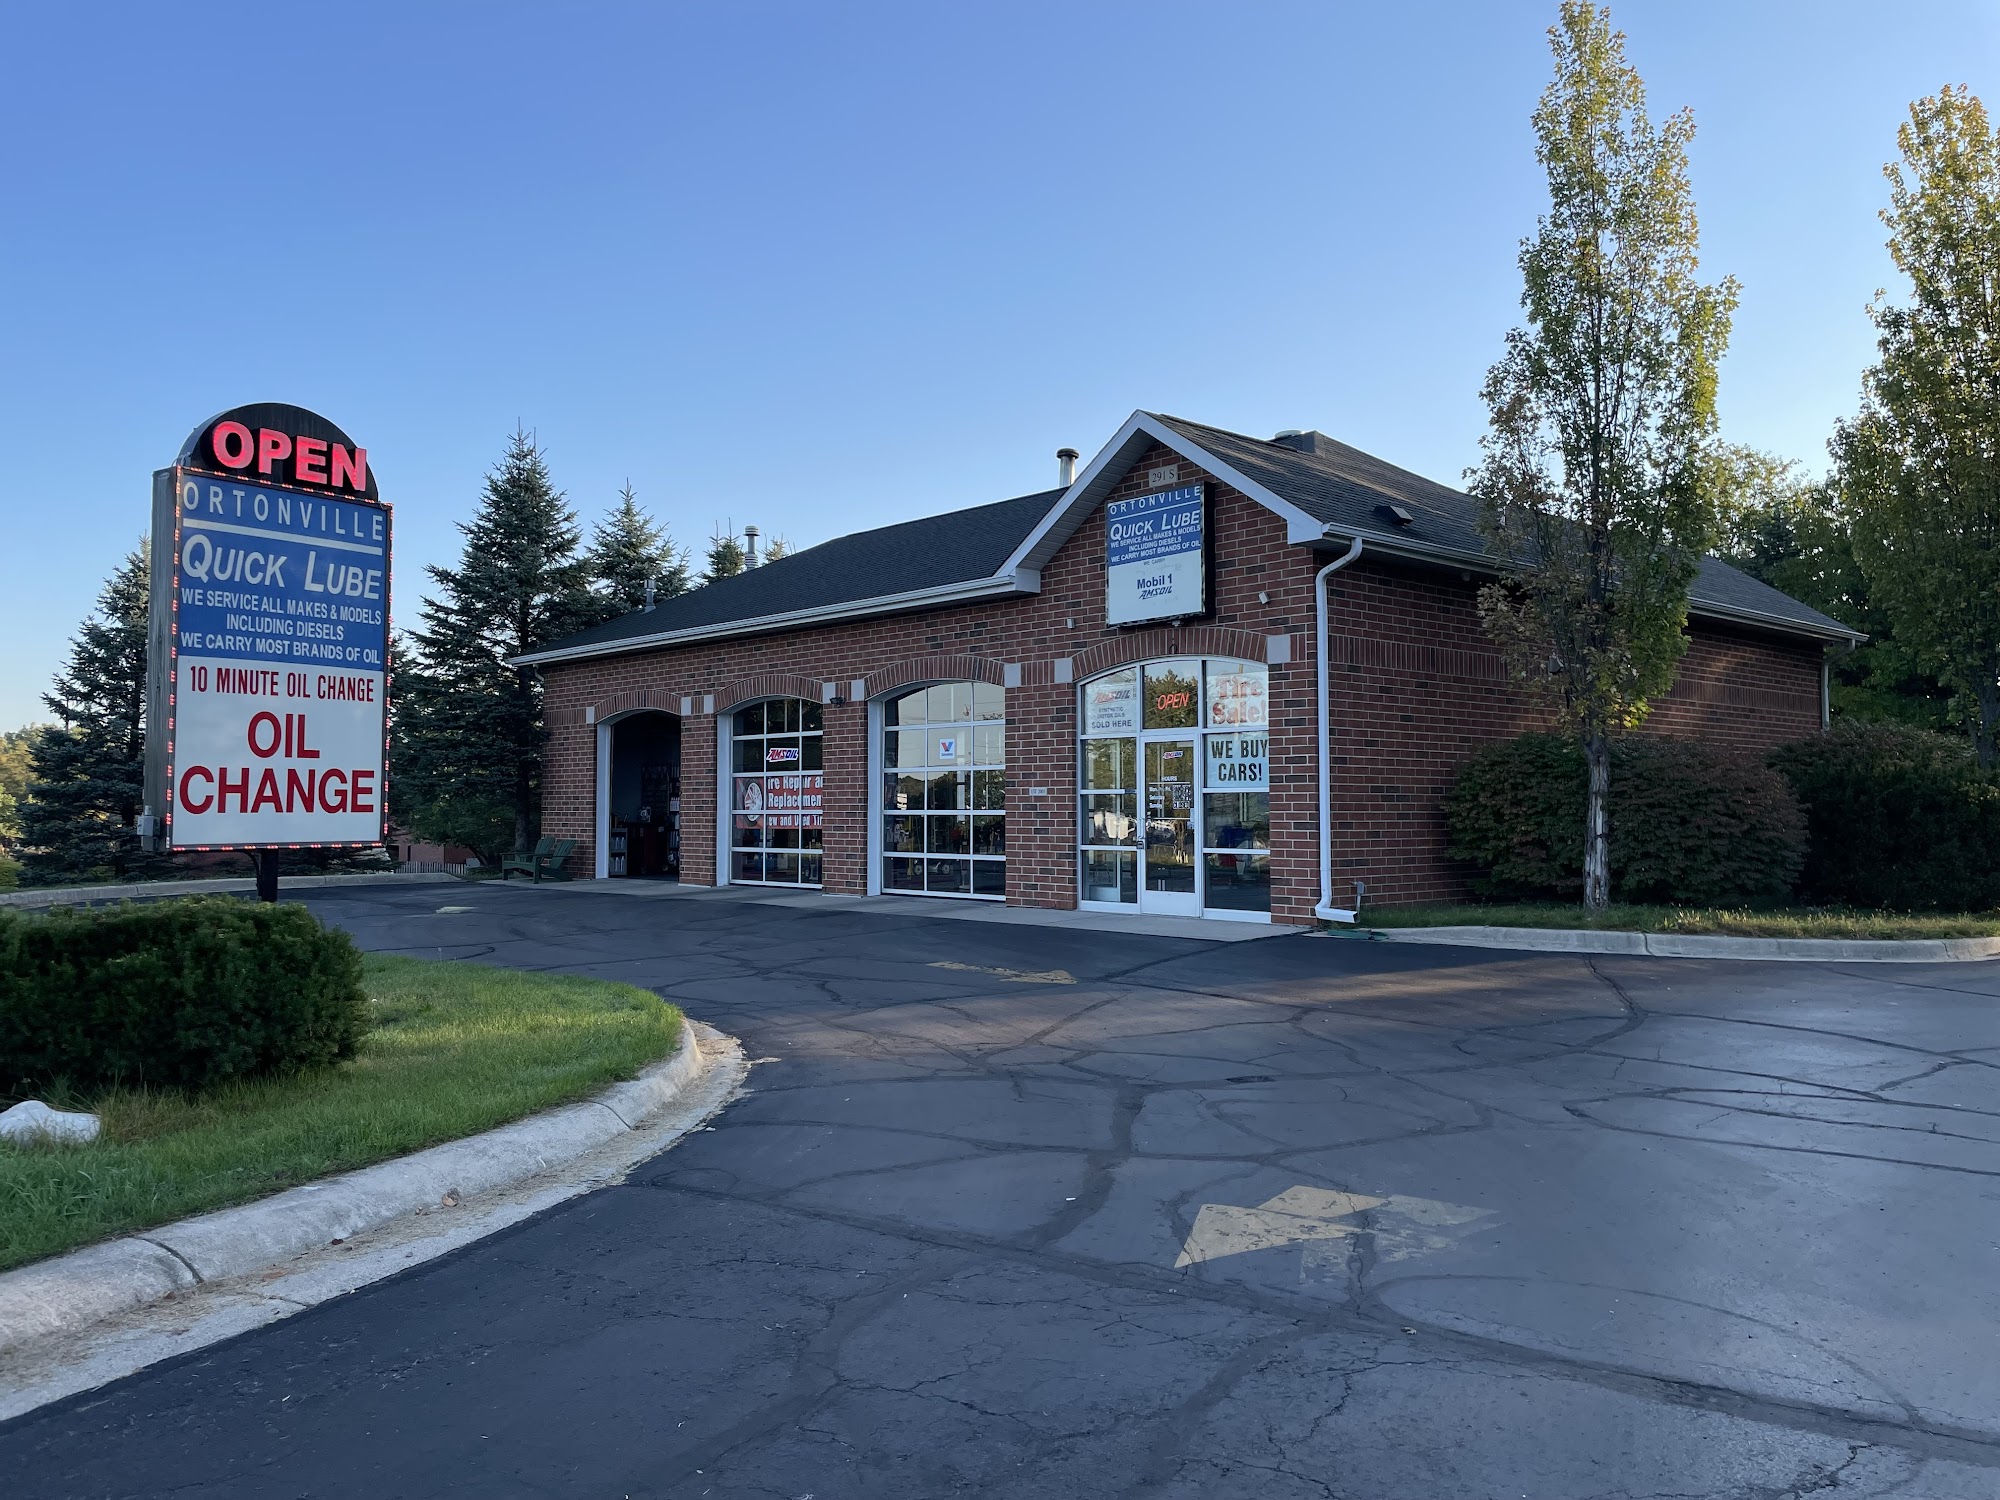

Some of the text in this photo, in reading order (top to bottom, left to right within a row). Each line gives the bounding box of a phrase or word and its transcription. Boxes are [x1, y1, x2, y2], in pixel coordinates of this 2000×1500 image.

[212, 420, 367, 492] OPEN
[1152, 469, 1175, 483] 291 S
[183, 482, 383, 540] ORTONVILLE
[1110, 485, 1200, 514] ORTONVILLE
[1110, 510, 1200, 541] QUICK LUBE
[1110, 541, 1120, 549] WE
[1120, 537, 1141, 547] SERVICE
[1142, 534, 1152, 542] ALL
[1153, 530, 1172, 540] MAKES
[1178, 524, 1200, 534] MODELS
[1111, 540, 1201, 563] WE CARRY MOST BRANDS OF OIL
[1128, 536, 1182, 552] INCLUDING DIESELS
[182, 534, 382, 599] QUICK LUBE
[1137, 573, 1173, 589] Mobil 1
[1139, 586, 1173, 600] AMSOIL
[181, 587, 382, 626] WE SERVICE ALL MAKES & MODELS
[226, 613, 344, 641] INCLUDING DIESELS
[181, 631, 381, 665] WE CARRY MOST BRANDS OF OIL
[190, 665, 374, 702] 10 MINUTE OIL CHANGE
[1215, 676, 1263, 699] Tire
[1157, 692, 1190, 710] OPEN
[1212, 700, 1267, 724] Sale!
[247, 711, 320, 758] OIL
[1091, 720, 1132, 729] SOLD HERE
[766, 748, 799, 762] AMSOIL
[1211, 739, 1268, 758] WE BUY
[768, 776, 780, 790] ire
[1218, 763, 1262, 782] CARS!
[179, 765, 375, 814] CHANGE
[768, 815, 777, 826] ew
[780, 815, 792, 826] and
[794, 814, 810, 826] Ued
